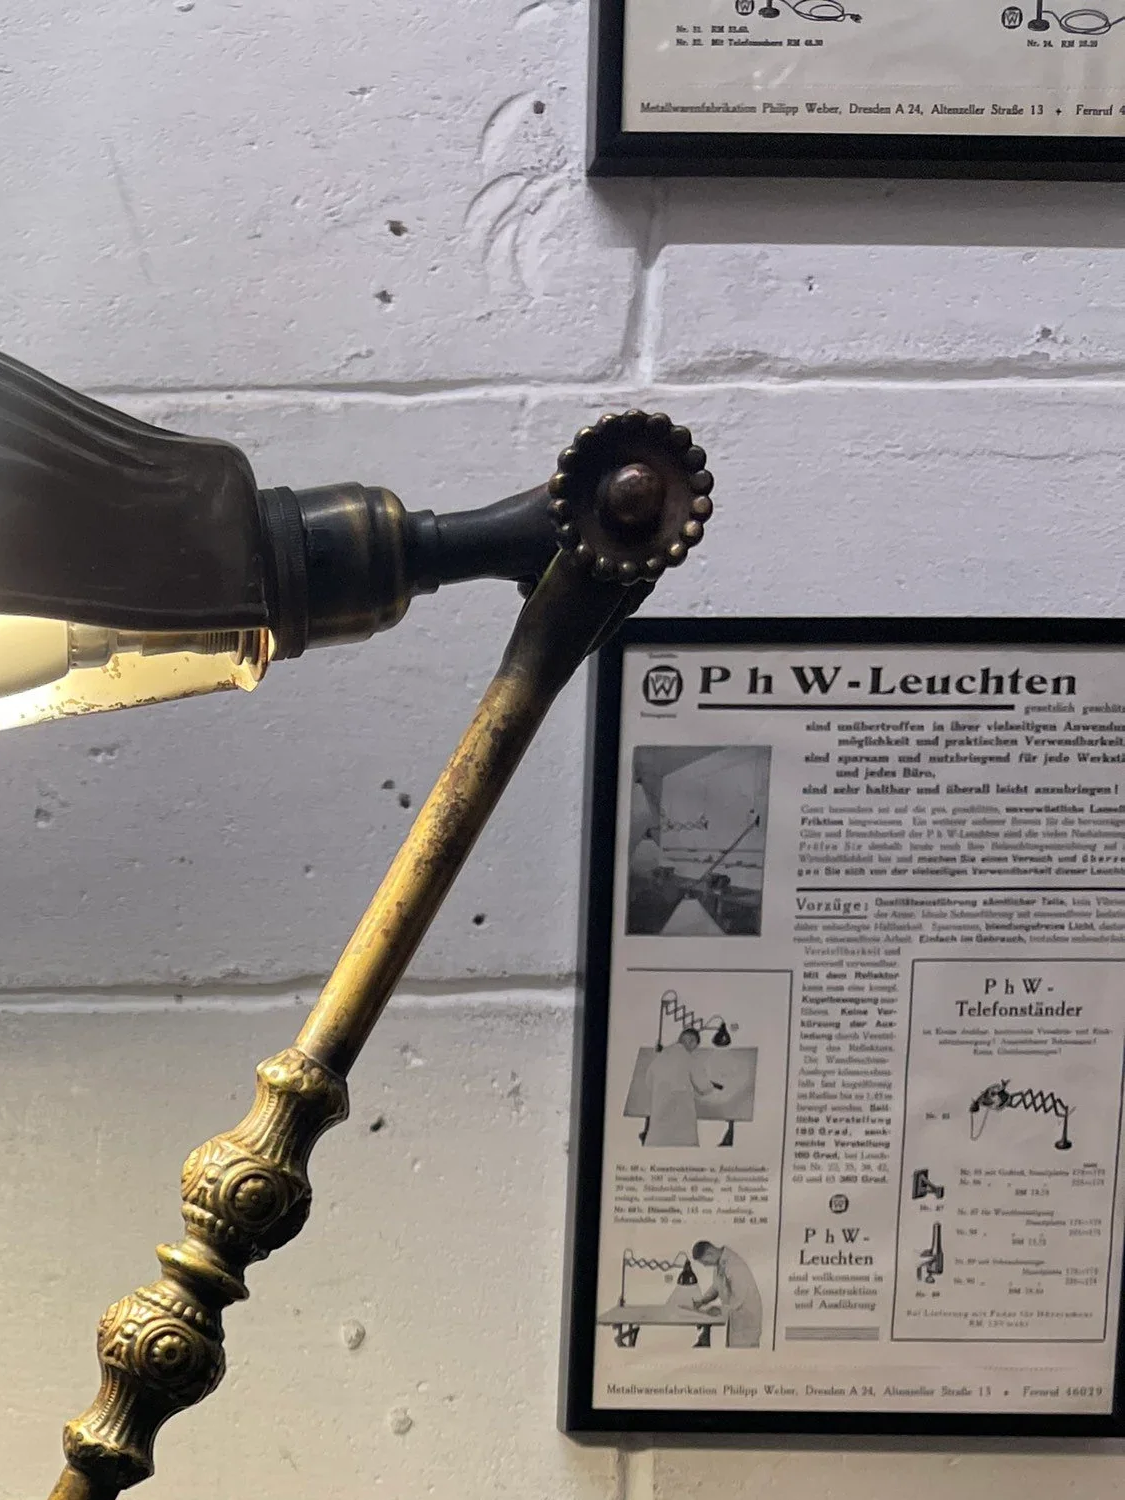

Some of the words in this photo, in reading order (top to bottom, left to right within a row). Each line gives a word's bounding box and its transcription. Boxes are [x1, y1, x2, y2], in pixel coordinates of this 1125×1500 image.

[640, 102, 757, 113] Metallwarenfabrikation
[762, 103, 799, 116] Philipp
[805, 103, 842, 115] Weber,
[849, 104, 891, 114] Dresden
[895, 104, 905, 114] A
[908, 104, 924, 116] 24,
[931, 104, 985, 115] Altenzeller
[991, 104, 1024, 115] Straße
[1030, 105, 1044, 115] 13
[1075, 104, 1114, 115] Fernruf
[806, 721, 831, 732] sind
[932, 722, 944, 732] in
[916, 736, 939, 747] und
[805, 753, 830, 763] sind
[898, 753, 921, 764] und
[1018, 752, 1037, 763] für
[836, 768, 859, 778] und
[802, 784, 827, 795] sind
[833, 785, 860, 795] sehr
[916, 784, 940, 795] und
[996, 784, 1028, 795] leicht
[955, 1001, 1083, 1017] Telefonständer
[799, 1250, 873, 1265] Leuchten
[607, 1384, 717, 1395] Metallwarenfabrikation
[723, 1384, 758, 1398] Philipp
[849, 1385, 858, 1395] A
